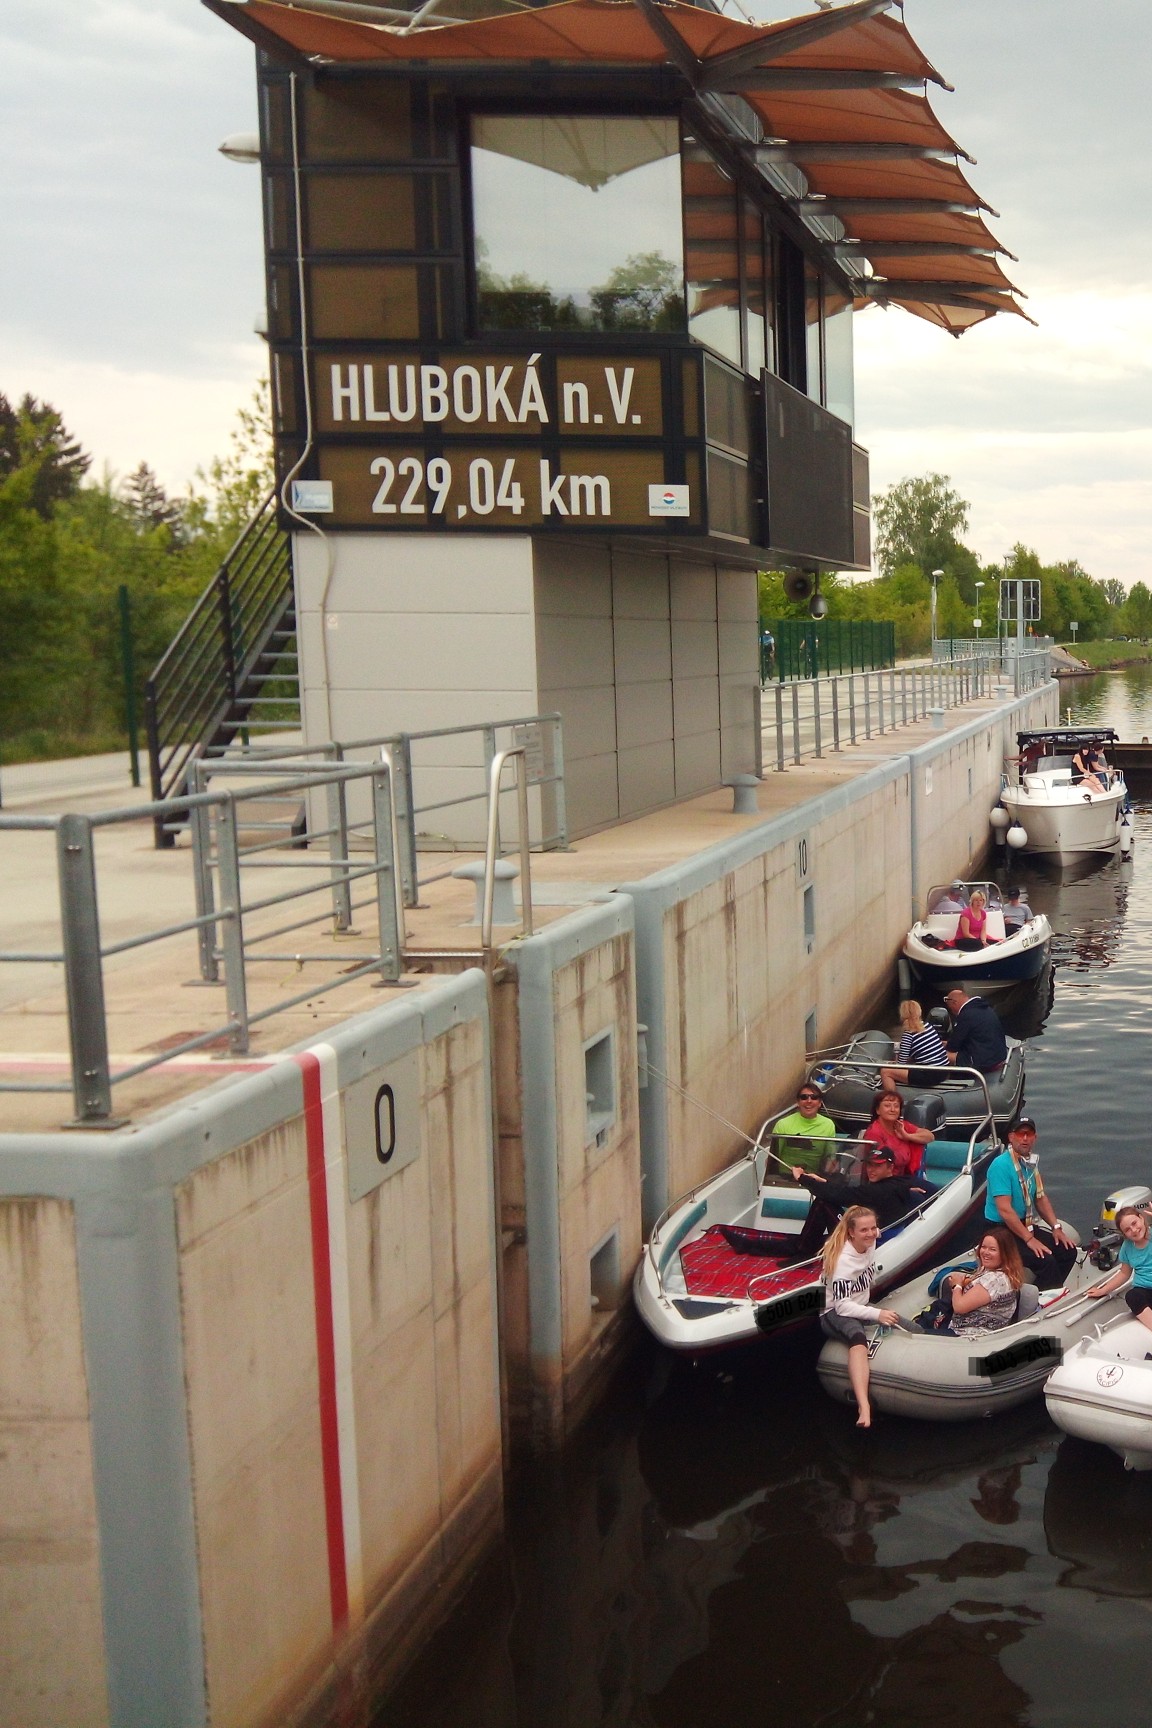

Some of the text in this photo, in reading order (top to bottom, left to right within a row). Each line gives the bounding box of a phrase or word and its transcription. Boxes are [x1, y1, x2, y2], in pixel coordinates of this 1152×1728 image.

[330, 352, 643, 425] HLUBOKÁ n.V.
[369, 456, 612, 520] 229,04 km
[799, 838, 808, 878] 10
[374, 1083, 396, 1165] 0
